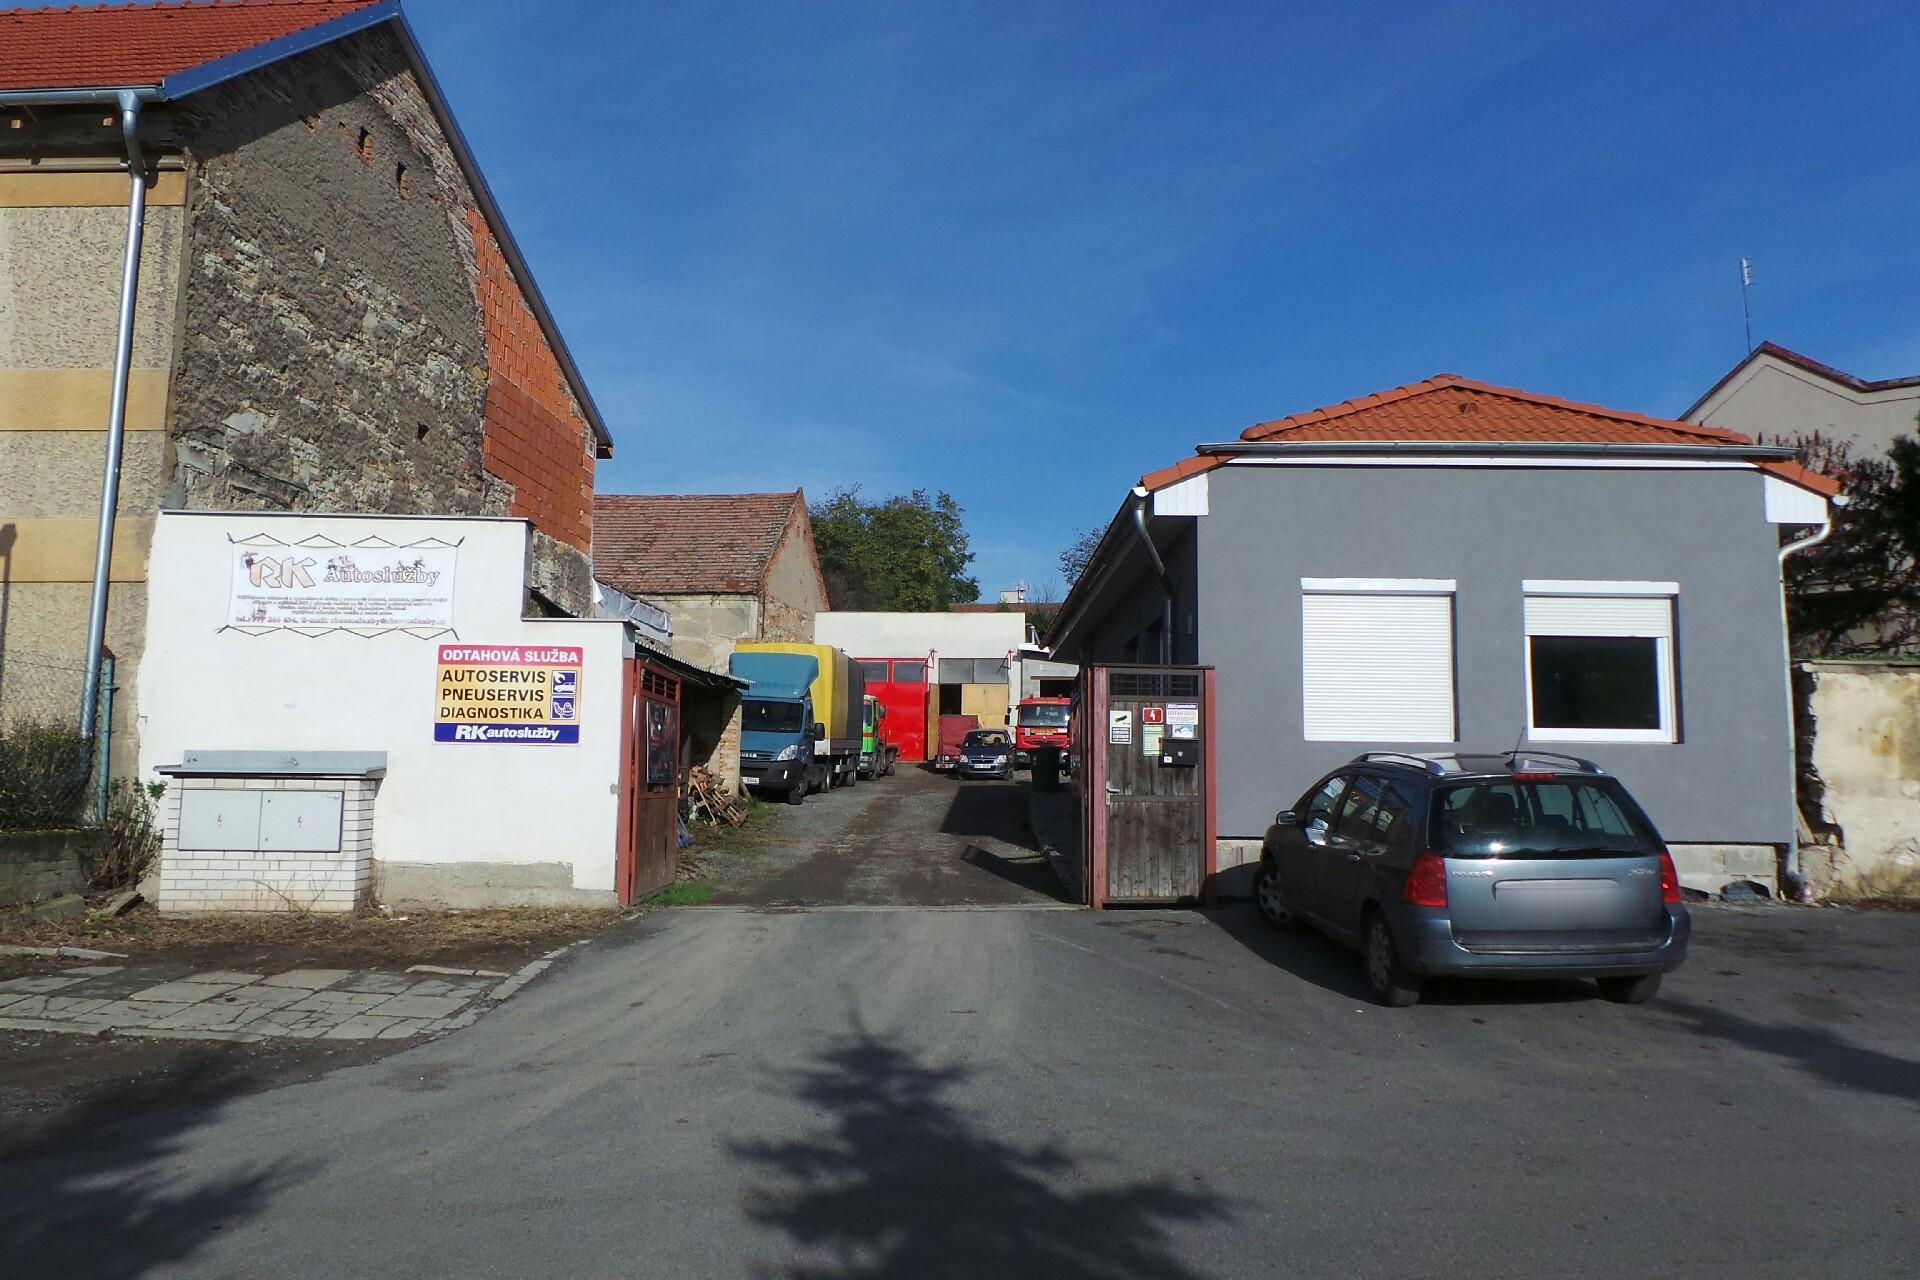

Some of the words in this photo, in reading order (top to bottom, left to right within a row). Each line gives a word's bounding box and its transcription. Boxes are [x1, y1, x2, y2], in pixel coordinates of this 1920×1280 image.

[250, 556, 317, 588] RK
[323, 565, 441, 586] Autoslužby
[442, 648, 521, 662] ODTAHOVÁ
[524, 648, 579, 663] SLUŽBA
[442, 670, 546, 683] AUTOSERVIS
[442, 688, 544, 702] PNEUSERVIS
[440, 707, 544, 719] DIAGNOSTIKA
